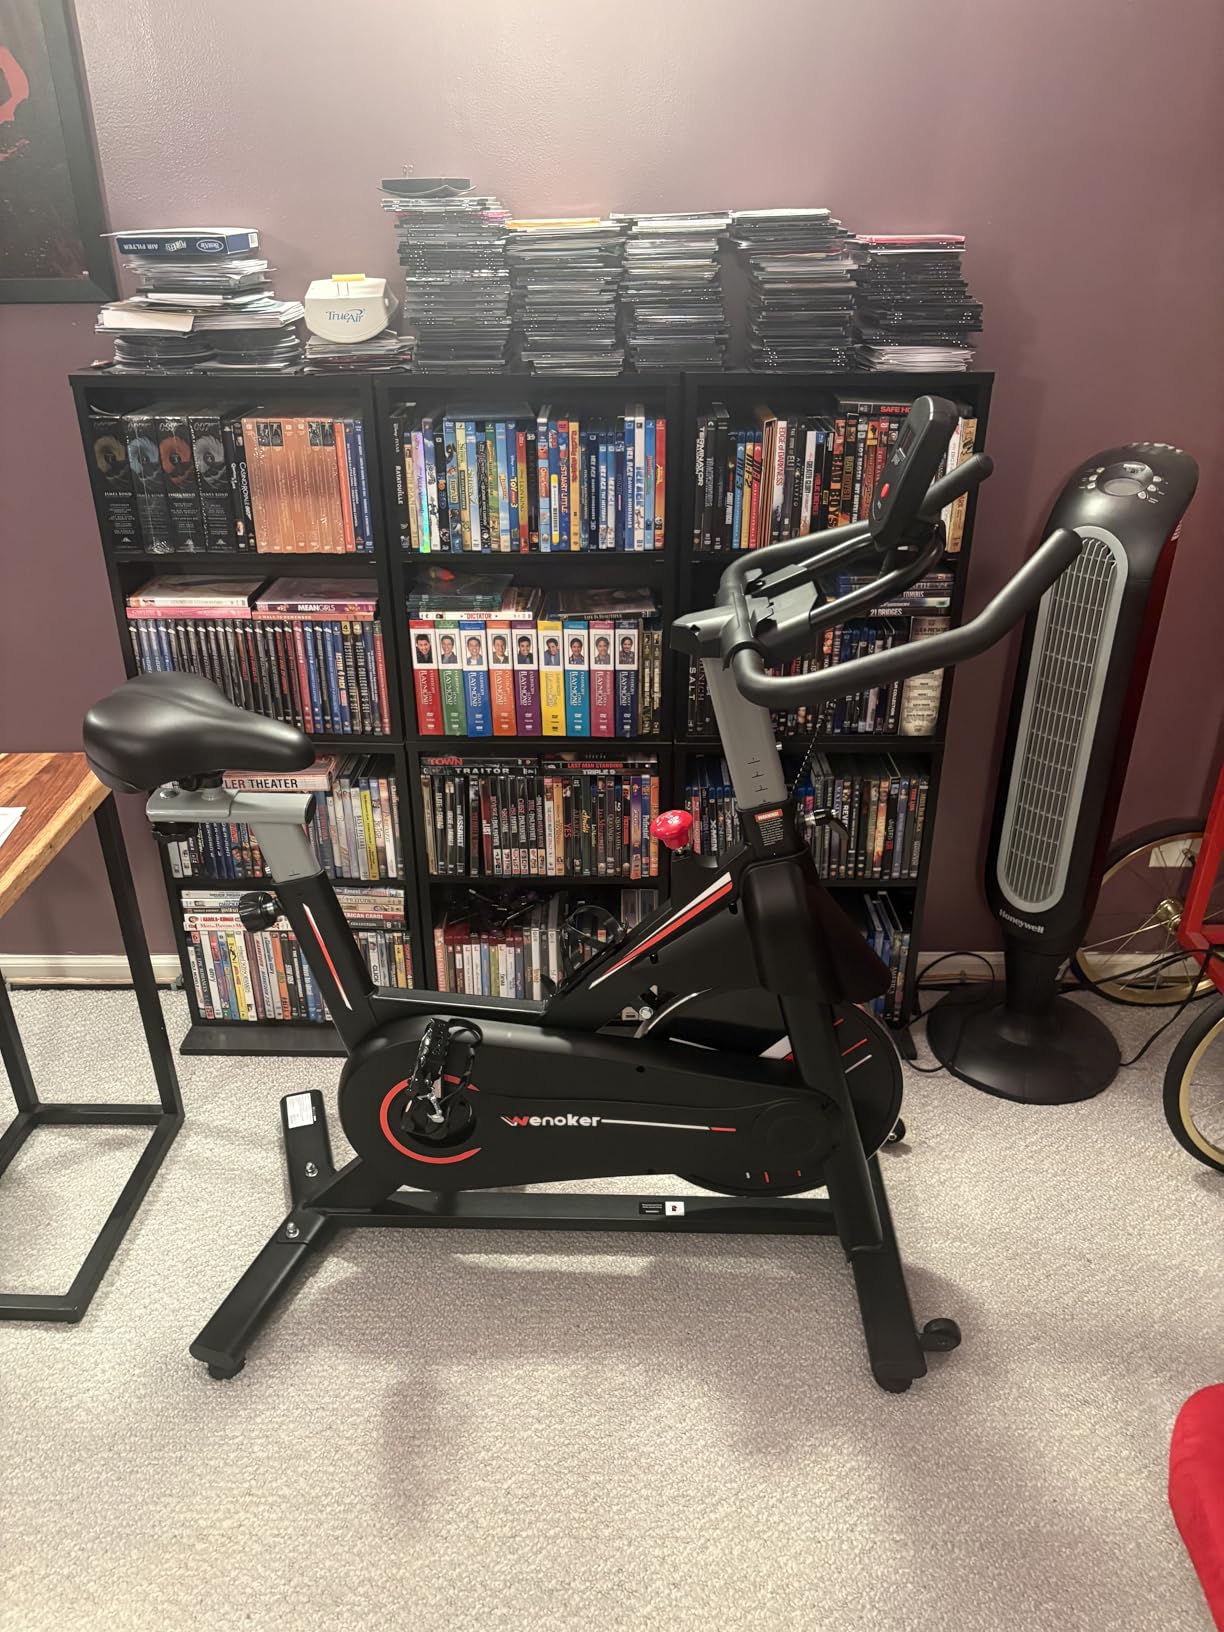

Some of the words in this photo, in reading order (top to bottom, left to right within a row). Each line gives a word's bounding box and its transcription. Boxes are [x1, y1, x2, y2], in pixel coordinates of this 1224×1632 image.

[778, 426, 787, 445] EDGE
[697, 426, 705, 487] TERMINATOR
[775, 451, 786, 487] DARKNESS
[786, 455, 796, 466] ELI
[855, 457, 863, 480] SHOTS!
[239, 462, 248, 485] CASINO
[559, 467, 568, 491] STUART
[626, 462, 634, 477] AGE
[793, 457, 801, 507] APOCALYPTO
[560, 493, 568, 513] LITTLE
[297, 604, 320, 612] MEAN
[877, 608, 903, 616] BRIDGES
[335, 652, 344, 671] ACTION
[344, 641, 353, 666] WESTERN
[355, 641, 365, 666] WESTERN
[337, 676, 346, 689] PACK
[346, 667, 357, 702] COLLECTOR'S
[357, 667, 368, 702] COLLECTOR'S
[420, 670, 429, 705] RAYMOND
[444, 670, 453, 705] RAYMOND
[469, 671, 478, 707] RAYMOND
[496, 670, 504, 705] RAYMOND
[519, 671, 528, 706] RAYMOND
[570, 671, 578, 706] RAYMOND
[620, 671, 628, 706] RAYMOND
[689, 667, 697, 701] SALT
[350, 703, 358, 713] SET
[362, 704, 370, 713] SET
[890, 689, 898, 716] COLLECTION
[224, 779, 246, 790] LER
[250, 778, 299, 790] THEATER
[356, 815, 364, 828] BEST
[456, 815, 464, 848] ASSAULT
[1000, 908, 1045, 935] Honeywell
